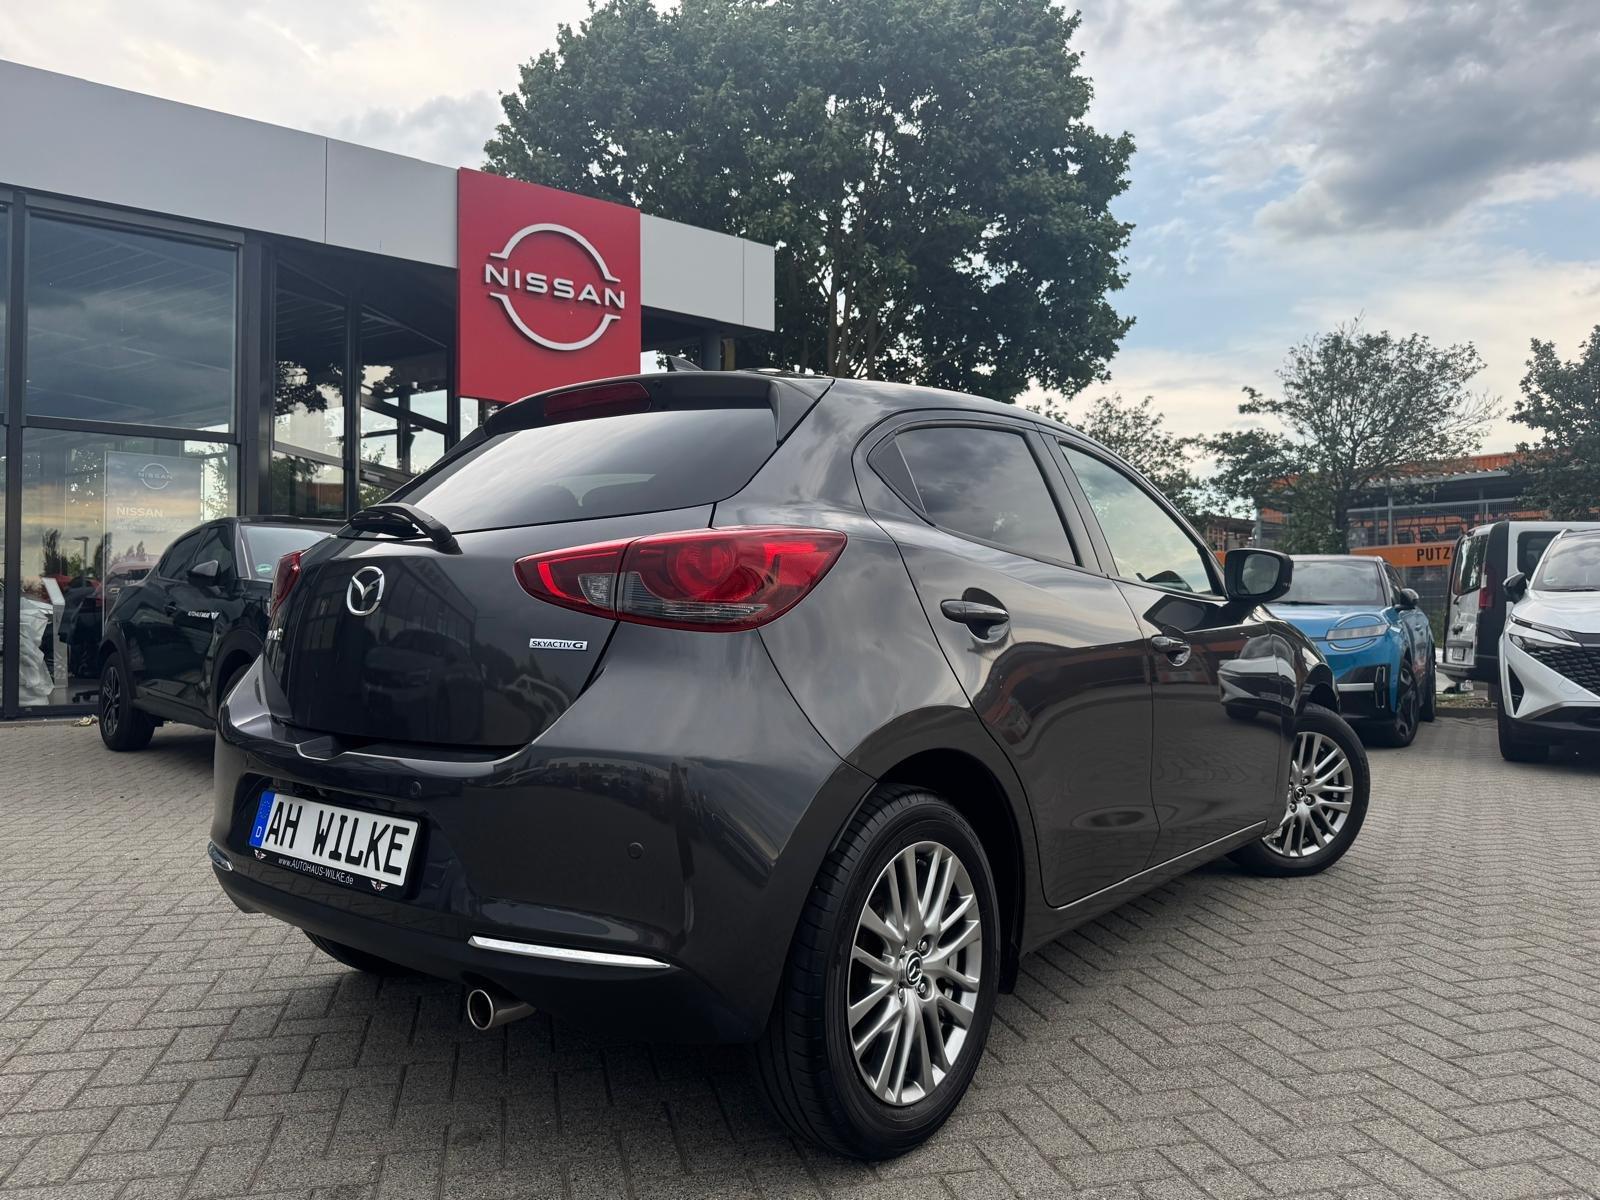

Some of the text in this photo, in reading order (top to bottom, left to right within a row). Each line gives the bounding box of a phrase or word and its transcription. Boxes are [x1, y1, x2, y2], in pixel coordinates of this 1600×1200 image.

[484, 263, 626, 310] NISSAN
[116, 506, 164, 518] NISSAN
[1416, 547, 1454, 563] PUTZ
[255, 825, 263, 838] D
[264, 800, 410, 876] AH WILKE
[277, 857, 355, 885] www.AUTOHAUS-WILKE.de
